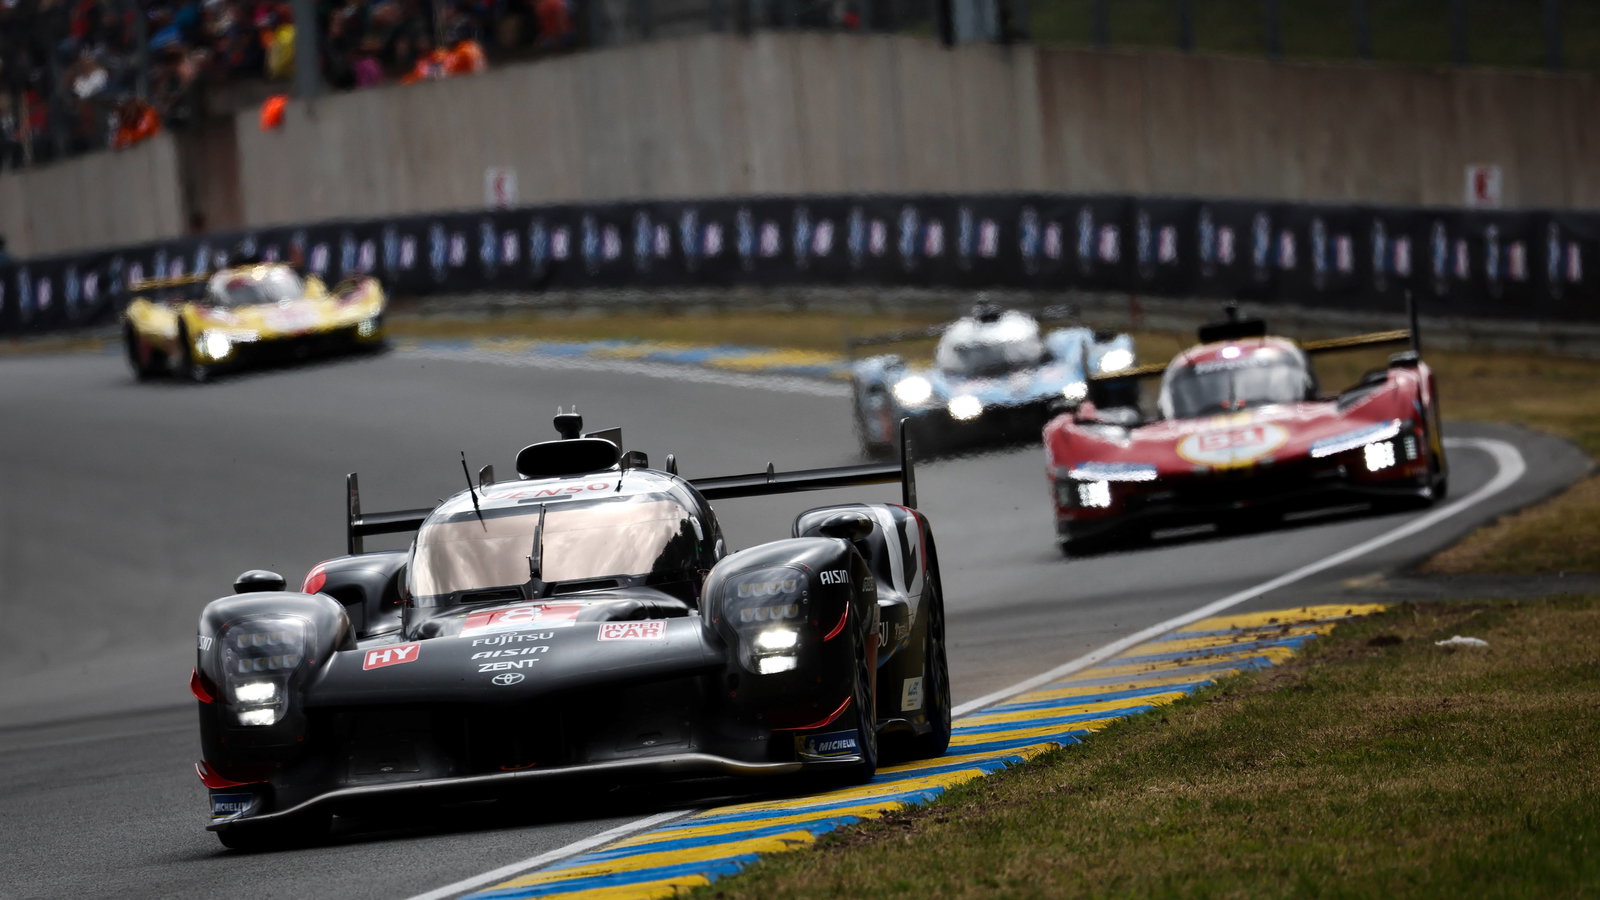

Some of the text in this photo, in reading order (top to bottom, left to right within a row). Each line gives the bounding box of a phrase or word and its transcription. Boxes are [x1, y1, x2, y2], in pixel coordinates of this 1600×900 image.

[486, 482, 610, 501] DENSO
[819, 569, 849, 586] AISIN
[499, 606, 543, 623] 8
[604, 628, 660, 640] CAR
[605, 622, 660, 631] HYPER
[472, 631, 554, 648] FUJITSU
[368, 645, 416, 666] HY
[471, 645, 550, 660] AISIN
[478, 658, 540, 673] ZENT
[818, 738, 856, 752] MICHELIN
